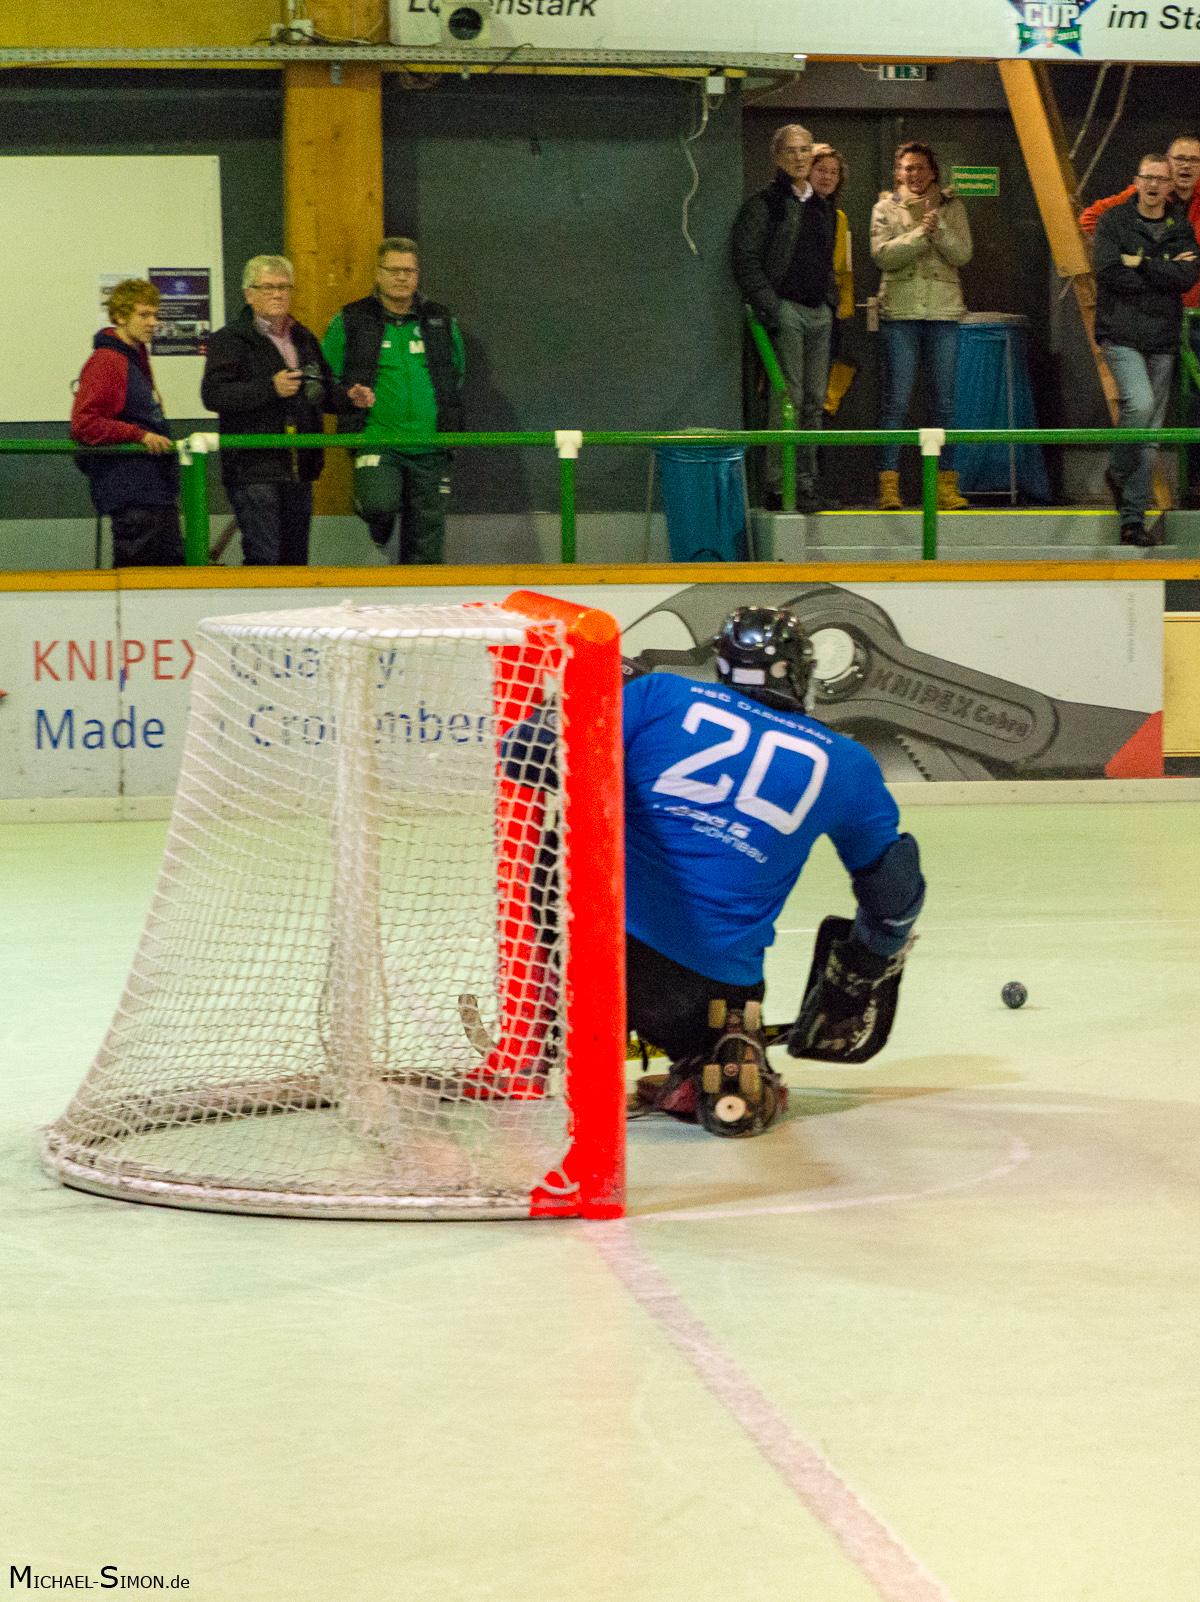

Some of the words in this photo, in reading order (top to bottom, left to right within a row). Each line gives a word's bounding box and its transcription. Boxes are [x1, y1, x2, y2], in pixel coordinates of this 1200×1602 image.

[1024, 4, 1080, 28] CUP
[1107, 4, 1147, 29] im
[690, 686, 731, 703] RSC
[35, 705, 166, 750] Made
[651, 702, 830, 836] 20
